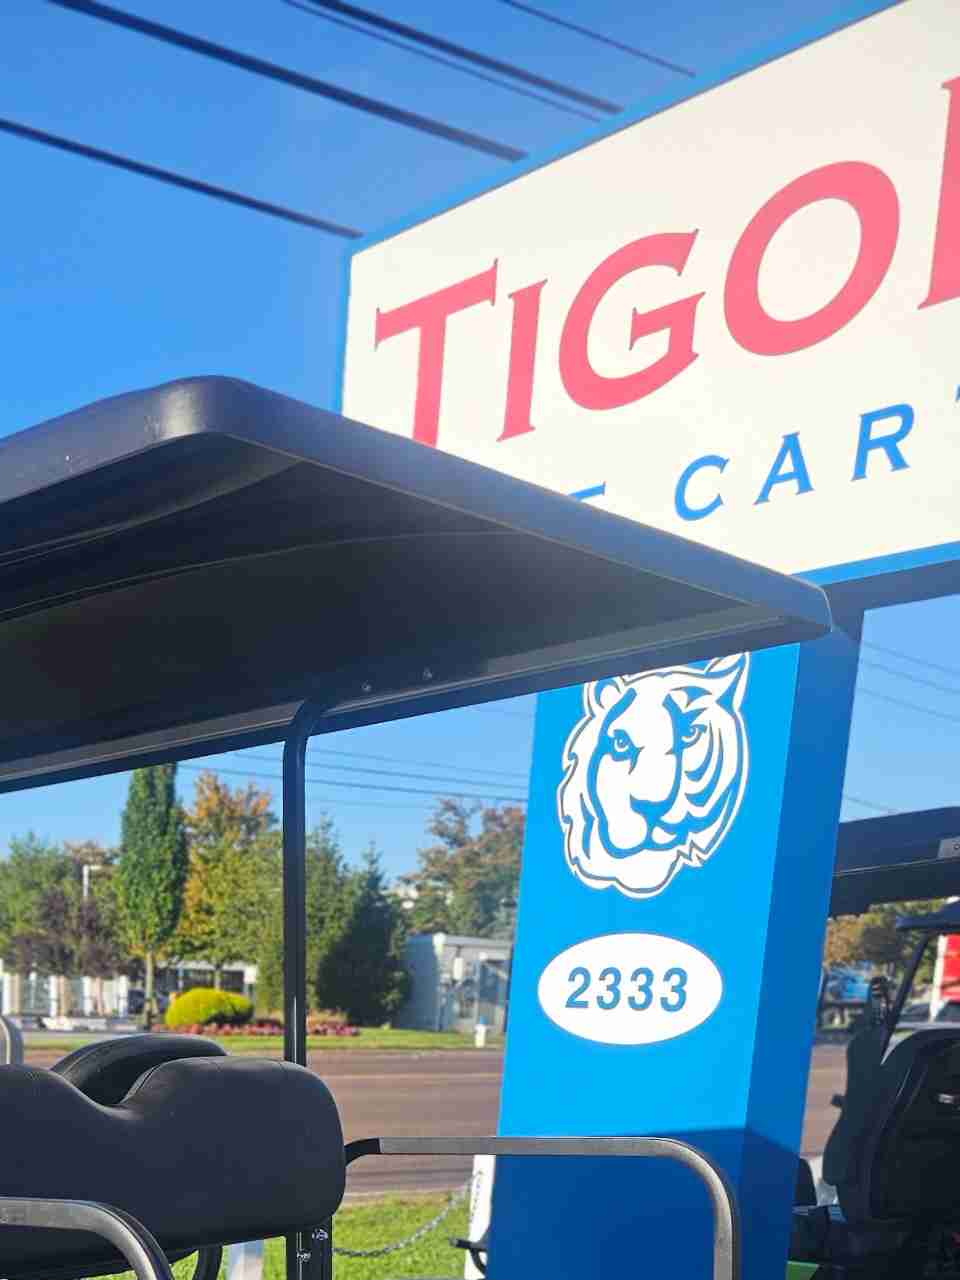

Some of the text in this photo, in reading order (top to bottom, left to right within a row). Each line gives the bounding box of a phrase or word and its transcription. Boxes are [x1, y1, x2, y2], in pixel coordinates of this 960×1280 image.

[374, 76, 960, 448] TIGO
[673, 383, 960, 522] CAR
[565, 966, 689, 1012] 2333
